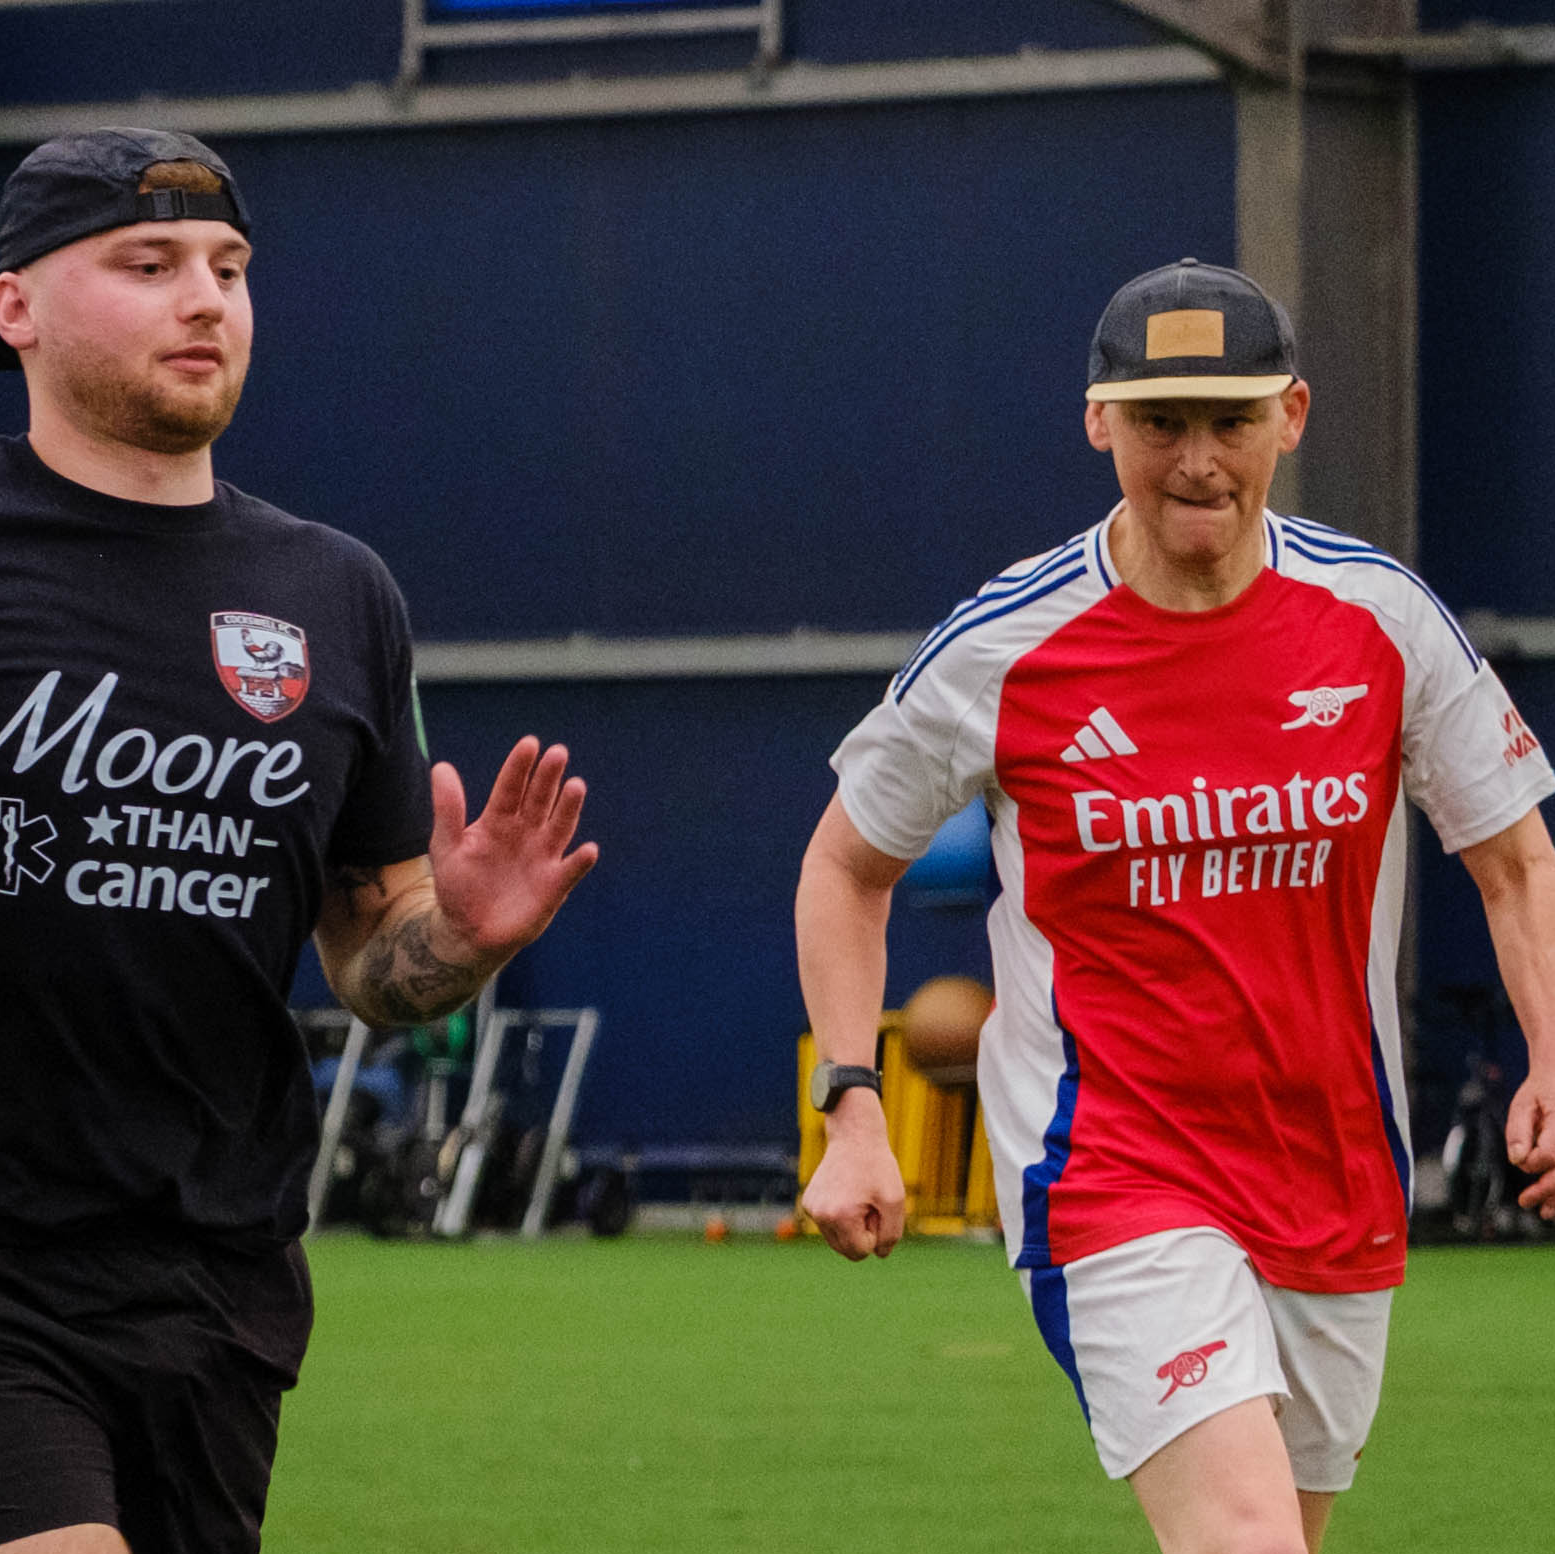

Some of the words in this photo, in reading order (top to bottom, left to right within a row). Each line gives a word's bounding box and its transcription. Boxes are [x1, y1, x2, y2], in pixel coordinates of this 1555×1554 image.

[1071, 771, 1368, 853] Emirates
[64, 859, 270, 918] cancer
[1129, 853, 1186, 908] FLY
[1201, 839, 1333, 898] BETTER
